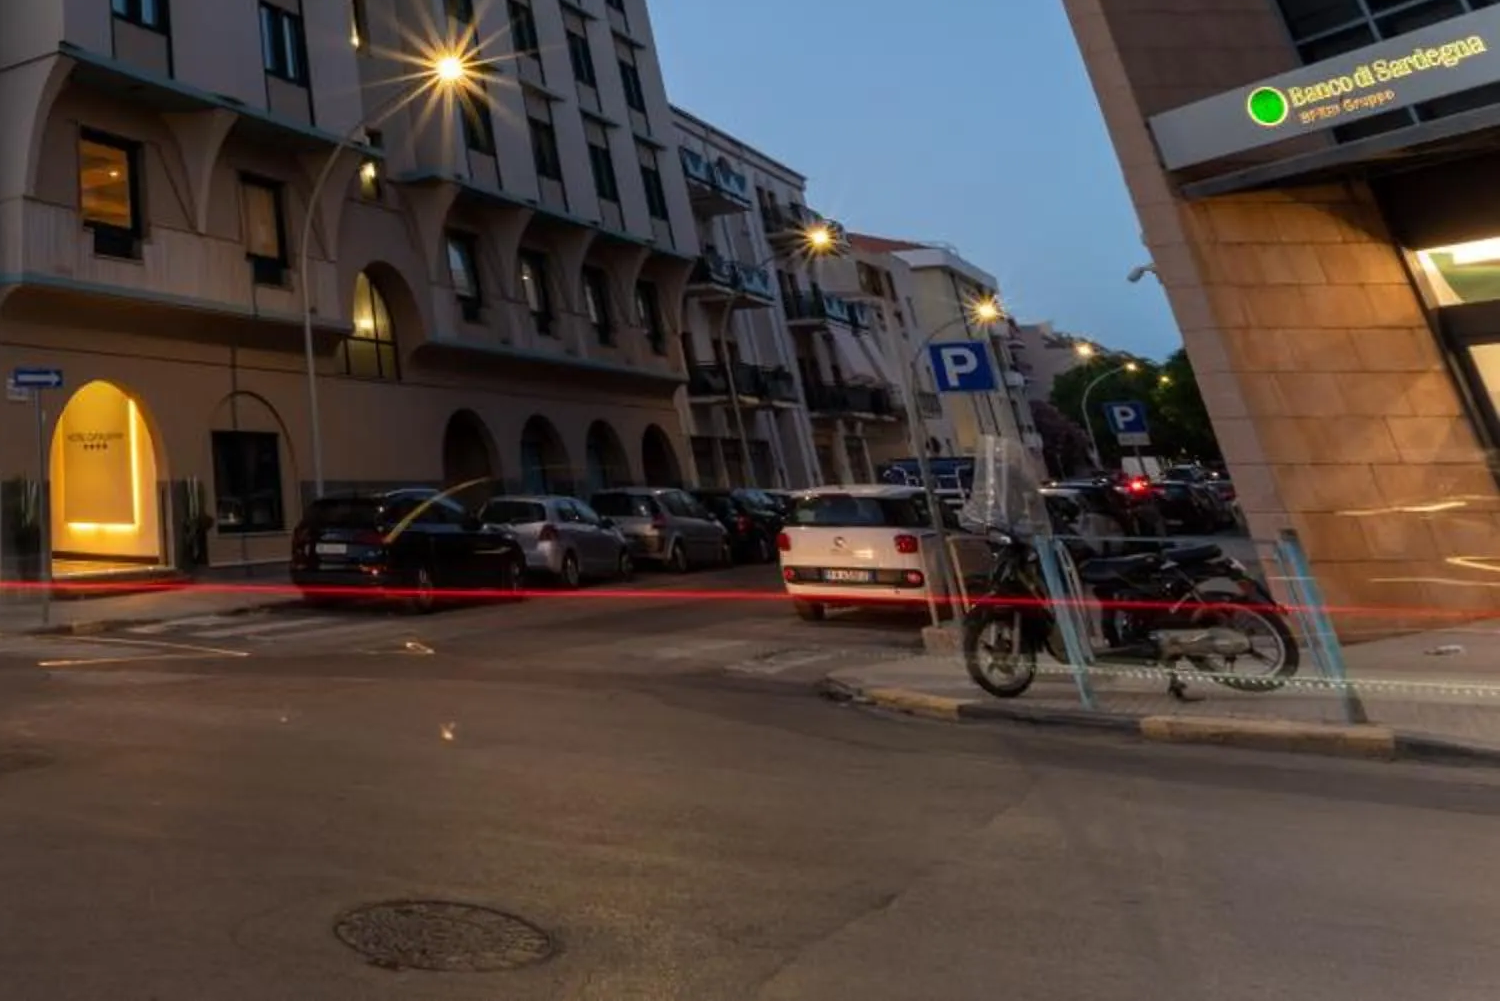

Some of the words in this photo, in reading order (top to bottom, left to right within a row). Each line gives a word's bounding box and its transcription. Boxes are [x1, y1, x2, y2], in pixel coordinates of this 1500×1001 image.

[1288, 75, 1353, 107] Banco
[1353, 64, 1375, 88] di
[1373, 35, 1487, 81] Sardegna
[941, 348, 978, 386] P
[1112, 406, 1137, 429] P
